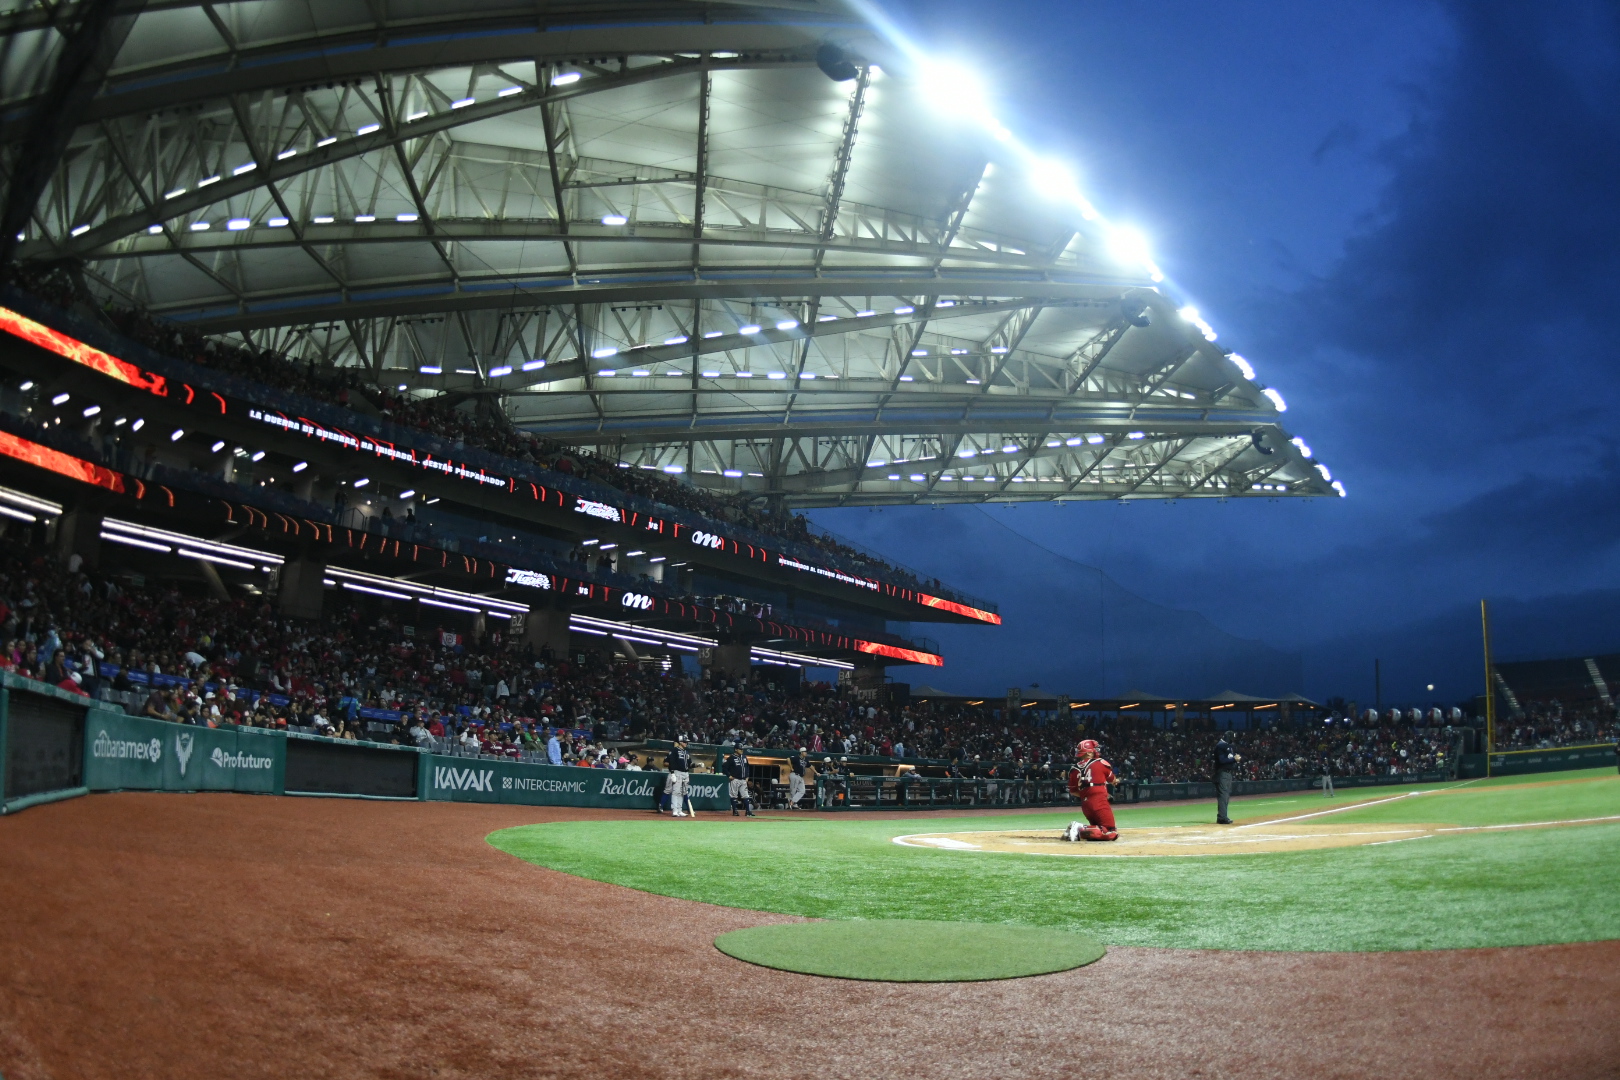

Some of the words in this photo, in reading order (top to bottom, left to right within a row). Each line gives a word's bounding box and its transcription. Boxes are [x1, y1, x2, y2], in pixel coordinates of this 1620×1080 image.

[249, 409, 262, 420] LA
[263, 413, 300, 430] GUERRA
[301, 424, 315, 435] DE
[93, 730, 149, 760] citibanamex
[223, 751, 272, 769] Profuturo
[434, 766, 494, 792] KAVAK
[515, 778, 586, 793] INTERCERAMIC
[687, 783, 723, 799] omex
